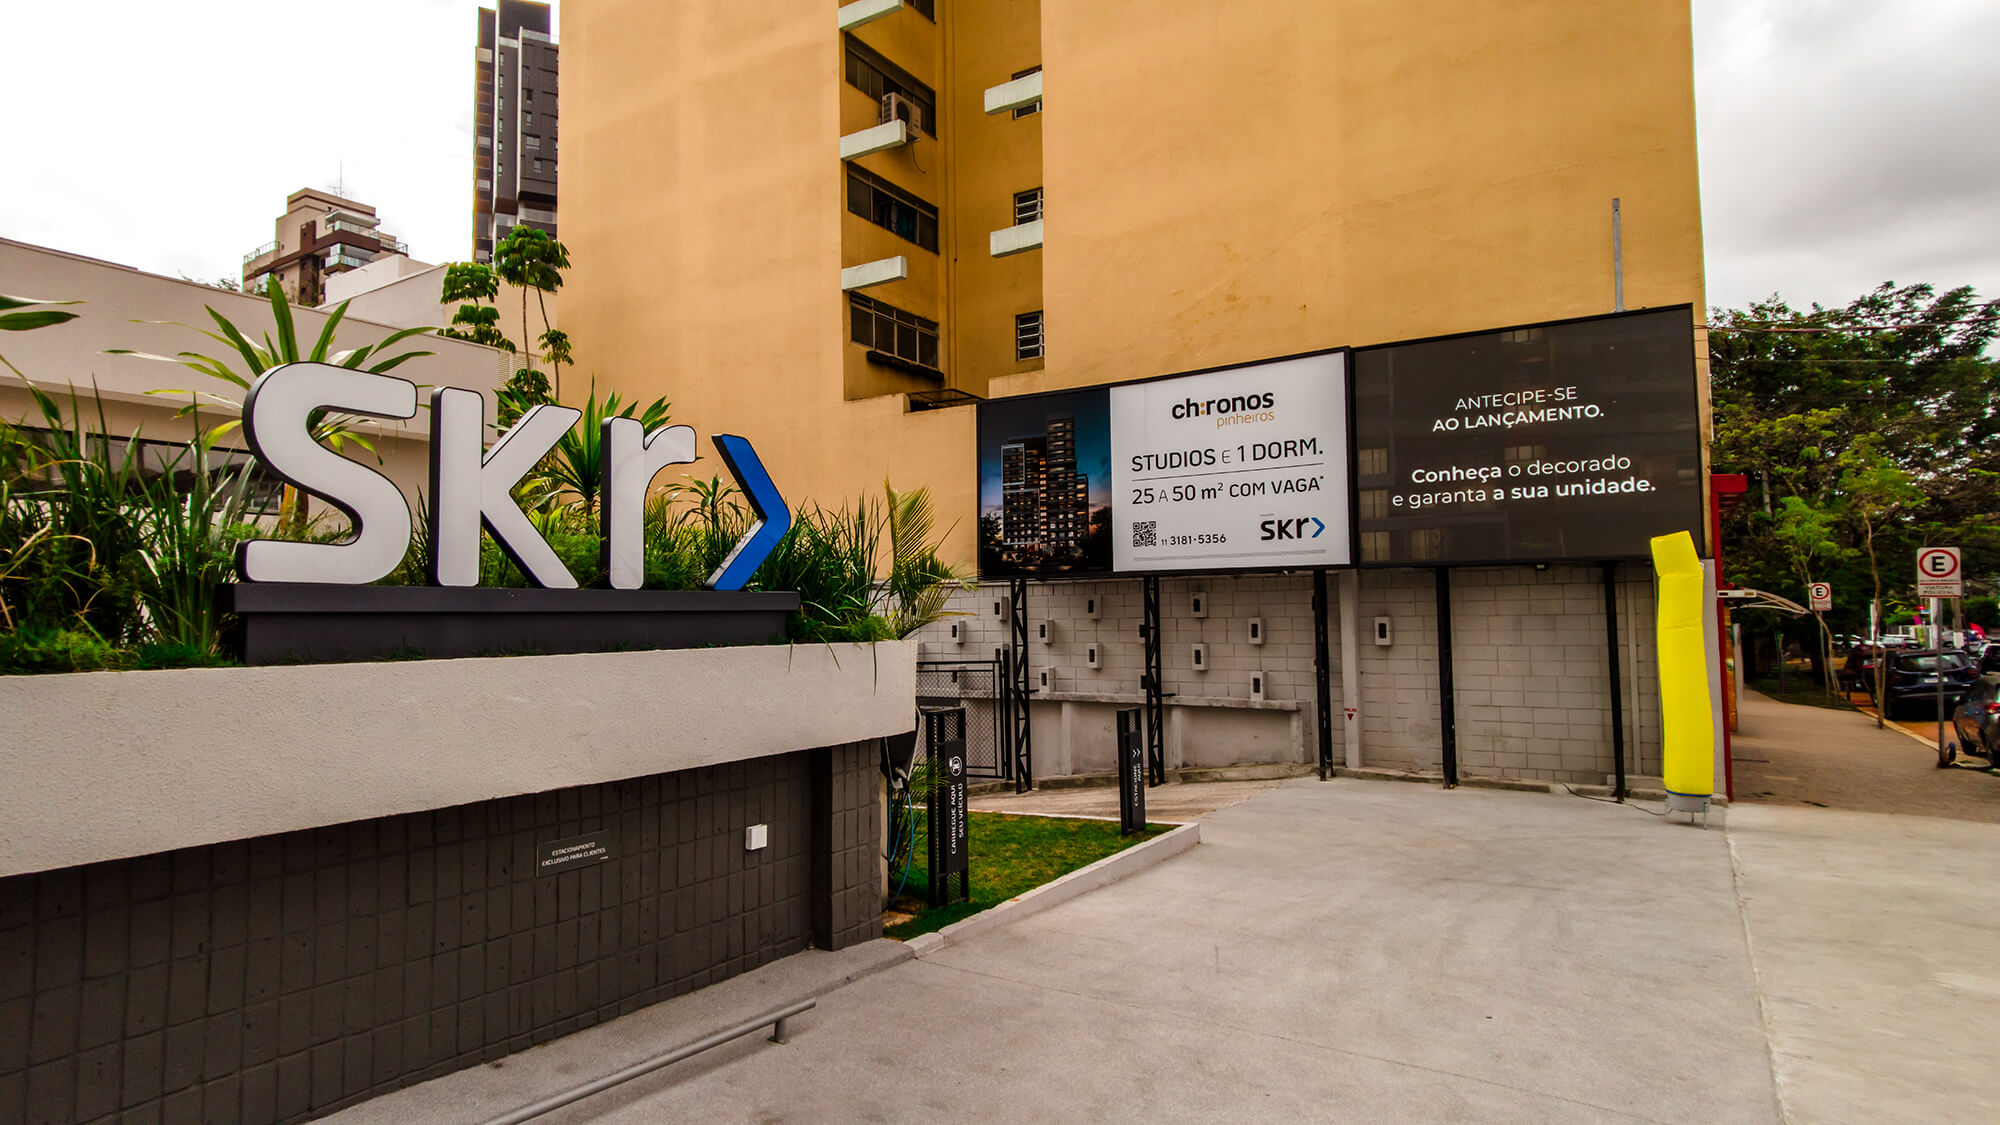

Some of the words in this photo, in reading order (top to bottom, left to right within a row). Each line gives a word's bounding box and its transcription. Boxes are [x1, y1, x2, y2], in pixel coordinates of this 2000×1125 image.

[1454, 386, 1578, 411] ANTECIPE-SE
[1216, 411, 1275, 430] pinheiros
[1432, 418, 1460, 432] AO
[1465, 404, 1605, 429] LANÇAMENTO.
[1131, 448, 1216, 472] STUDIOS
[1221, 449, 1232, 464] E
[1237, 445, 1245, 462] 1
[1252, 437, 1324, 461] DORM.
[1411, 465, 1502, 485] Conheça
[1508, 463, 1521, 477] o
[1527, 454, 1631, 476] decorado
[1132, 488, 1155, 505] 25
[1158, 490, 1169, 503] A
[1172, 484, 1196, 502] 50
[1229, 482, 1266, 498] COM
[1392, 494, 1404, 507] e
[1409, 488, 1486, 509] garanta
[1492, 488, 1505, 500] a
[1511, 485, 1549, 500] sua
[1556, 476, 1656, 497] unidade.
[1932, 556, 1946, 571] E
[1816, 587, 1824, 597] E
[541, 855, 570, 867] EXCLUSIVO
[583, 847, 606, 858] CLIENTES
